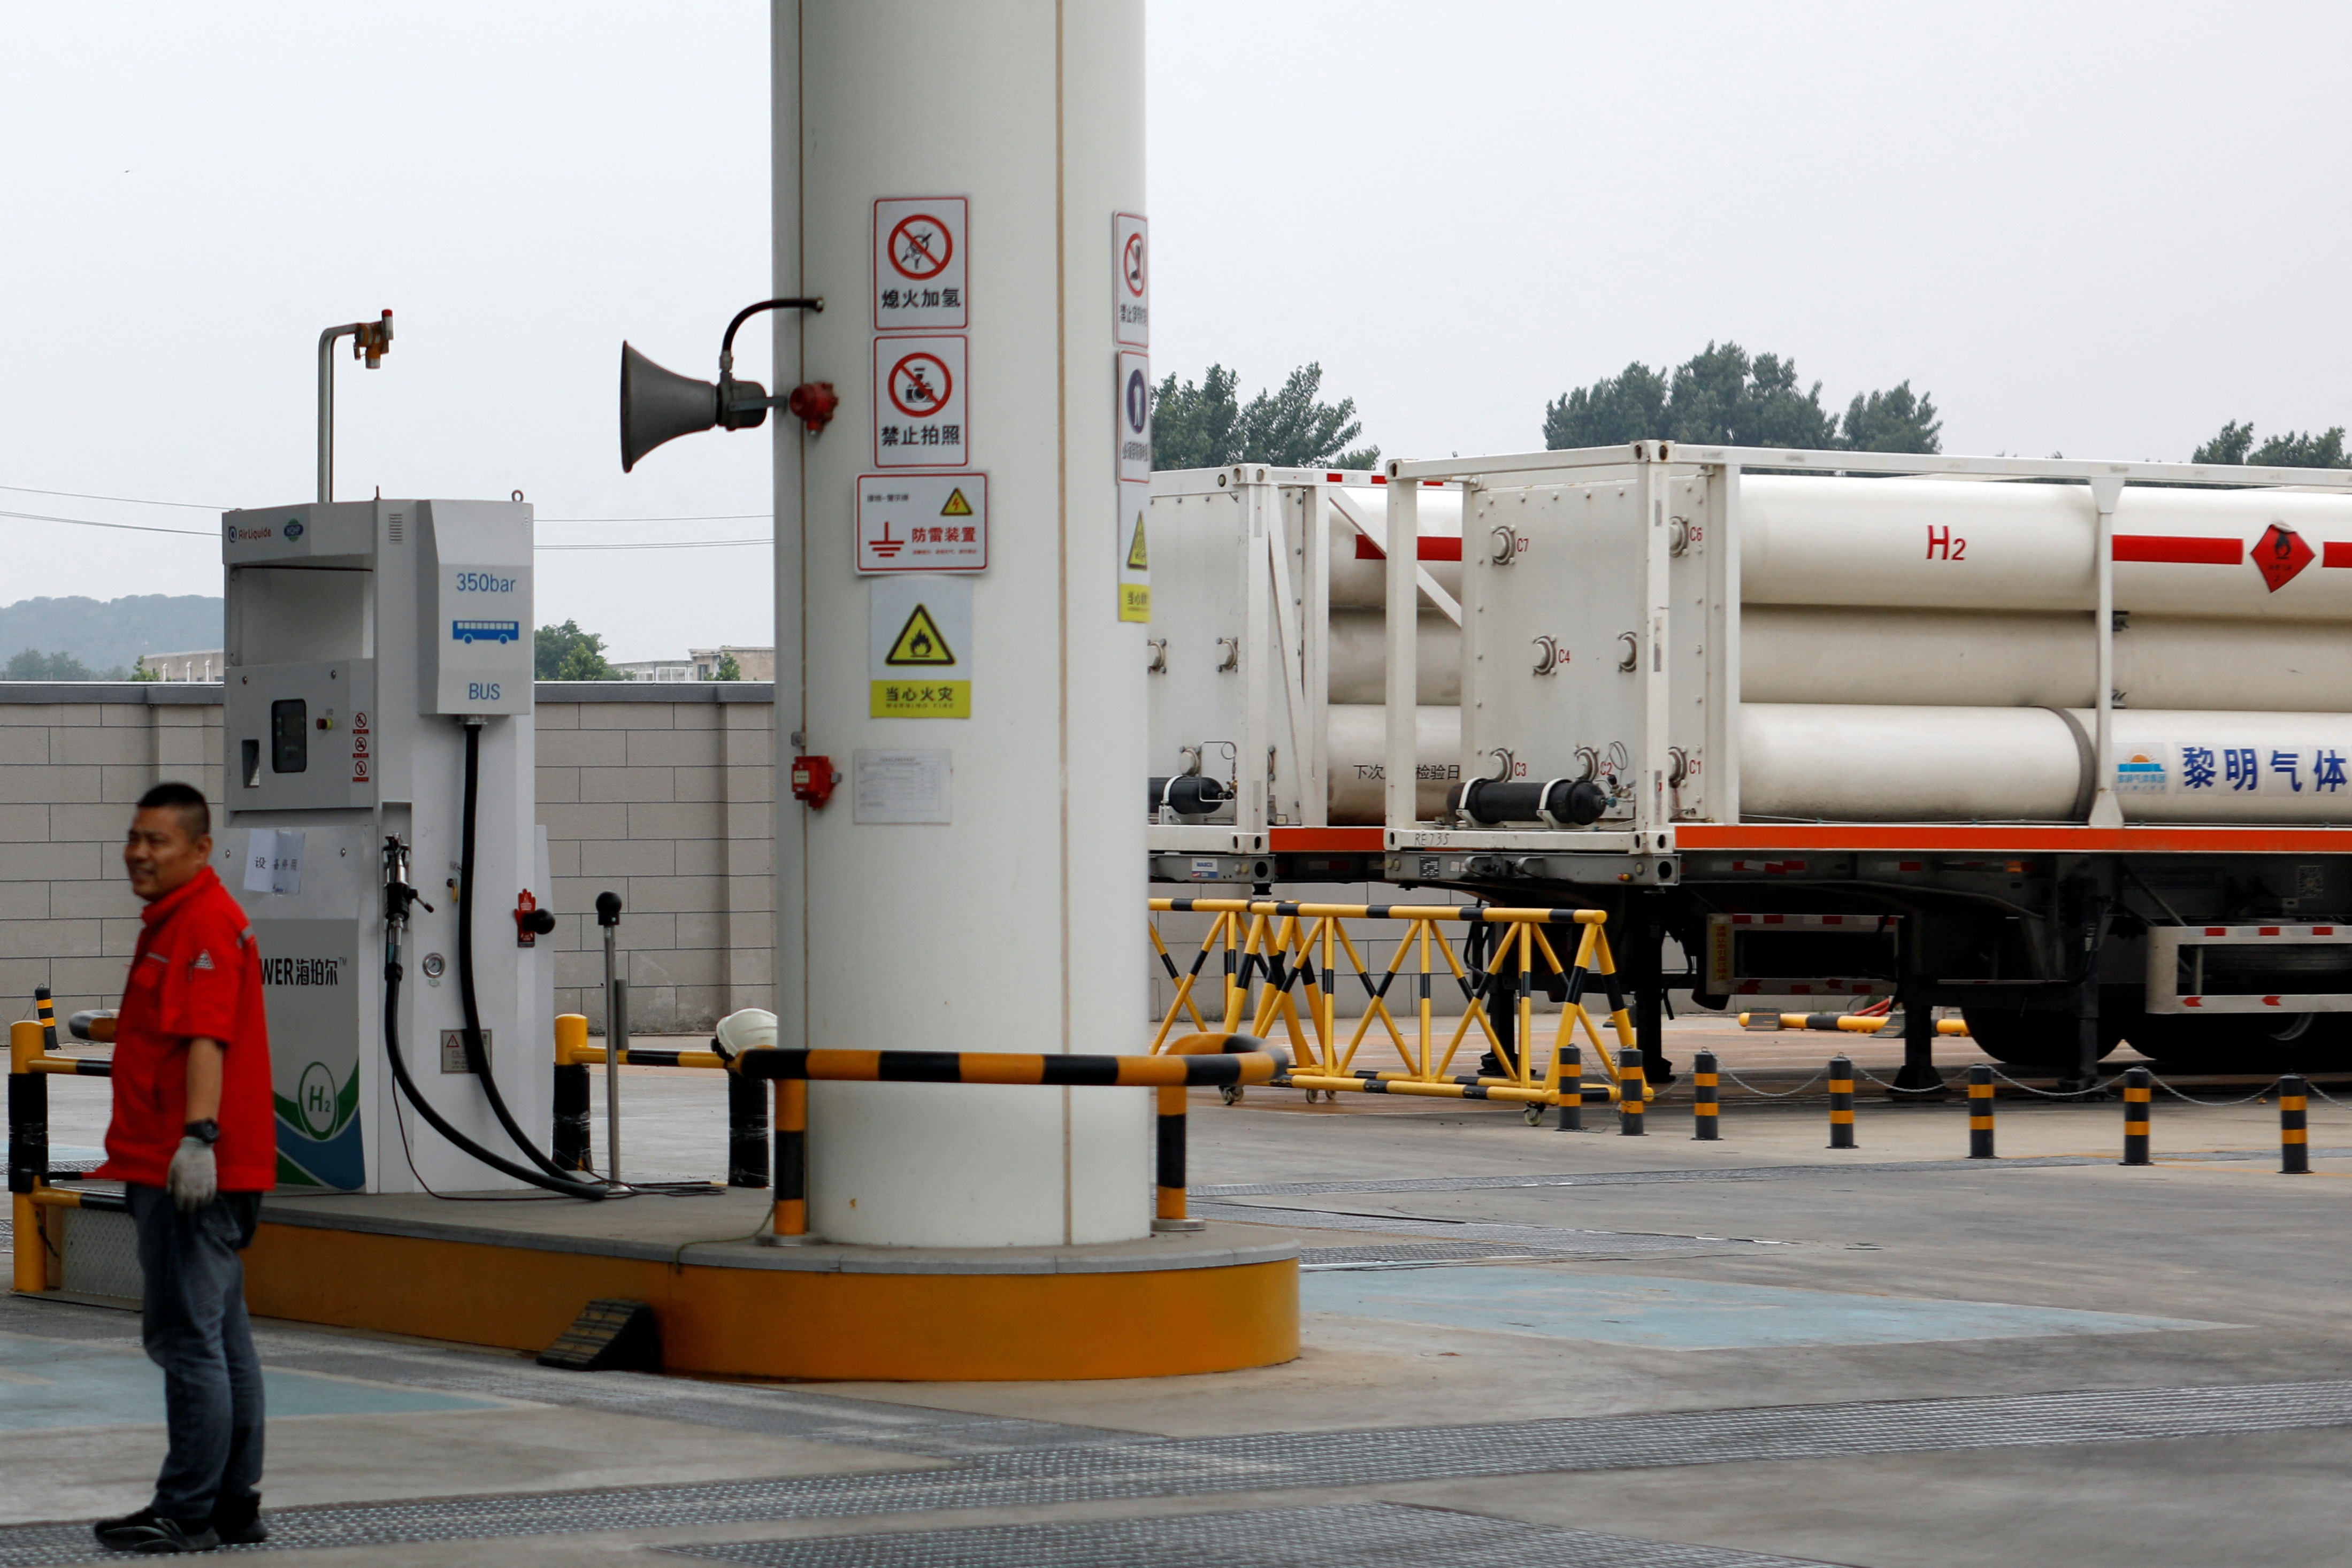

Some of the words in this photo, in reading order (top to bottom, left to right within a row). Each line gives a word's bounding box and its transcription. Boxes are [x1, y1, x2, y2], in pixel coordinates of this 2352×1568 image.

[882, 288, 960, 309] 熄火加氢
[881, 425, 960, 446] 禁止拍照
[912, 527, 976, 542] 防雷装置
[1689, 526, 1703, 541] C6
[1517, 537, 1529, 552] C7
[1927, 525, 1967, 560] H2
[456, 573, 516, 593] 350bar
[1559, 649, 1570, 664] C4
[469, 683, 500, 700] BUS
[886, 686, 954, 702] 当心火灾
[1514, 762, 1527, 777] C3
[1599, 760, 1613, 775] C2
[1689, 759, 1702, 774] C1
[2183, 747, 2347, 792] 黎明气体
[260, 958, 294, 985] WER
[296, 958, 338, 985] 海珀尔
[309, 1086, 331, 1112] H2
